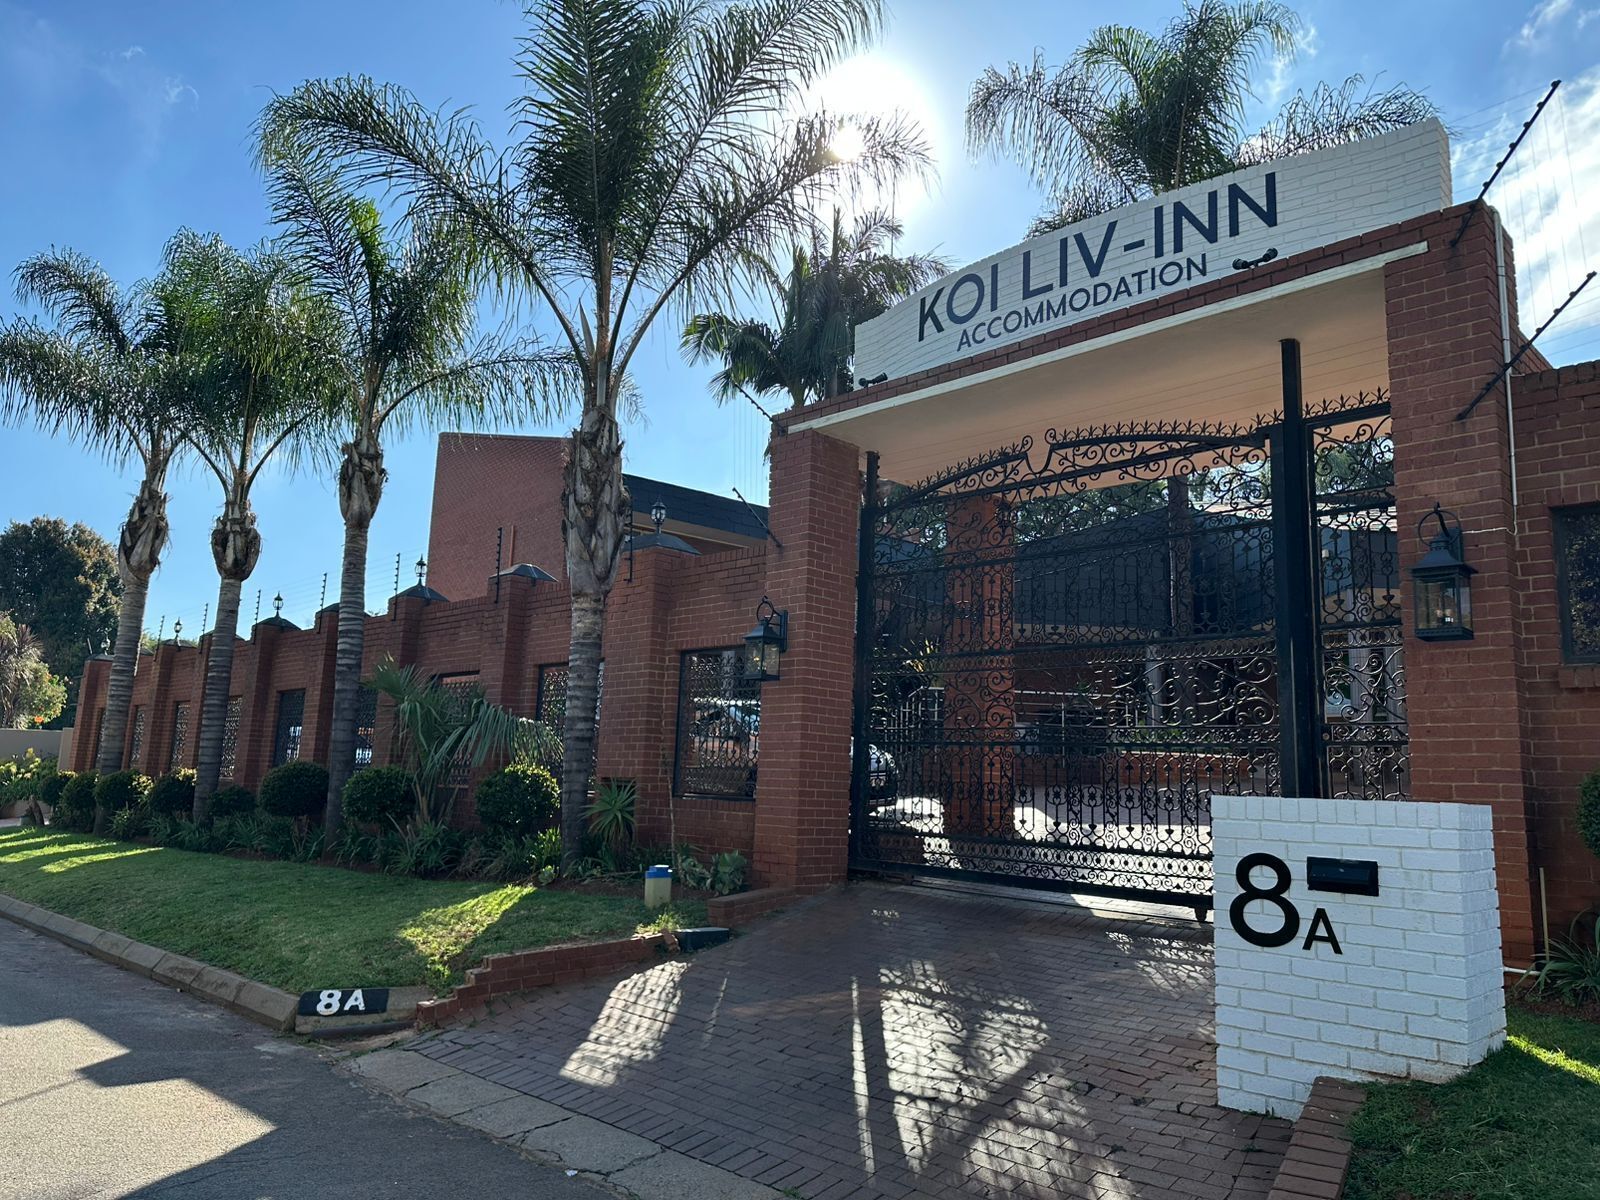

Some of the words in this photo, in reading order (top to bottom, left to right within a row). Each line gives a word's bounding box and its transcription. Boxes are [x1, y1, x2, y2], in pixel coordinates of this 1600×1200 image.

[918, 263, 998, 342] KOI
[1022, 172, 1278, 300] LIV-INN
[957, 253, 1208, 351] ACCOMMODATION
[1229, 852, 1343, 955] 8A
[316, 989, 366, 1016] 8A
